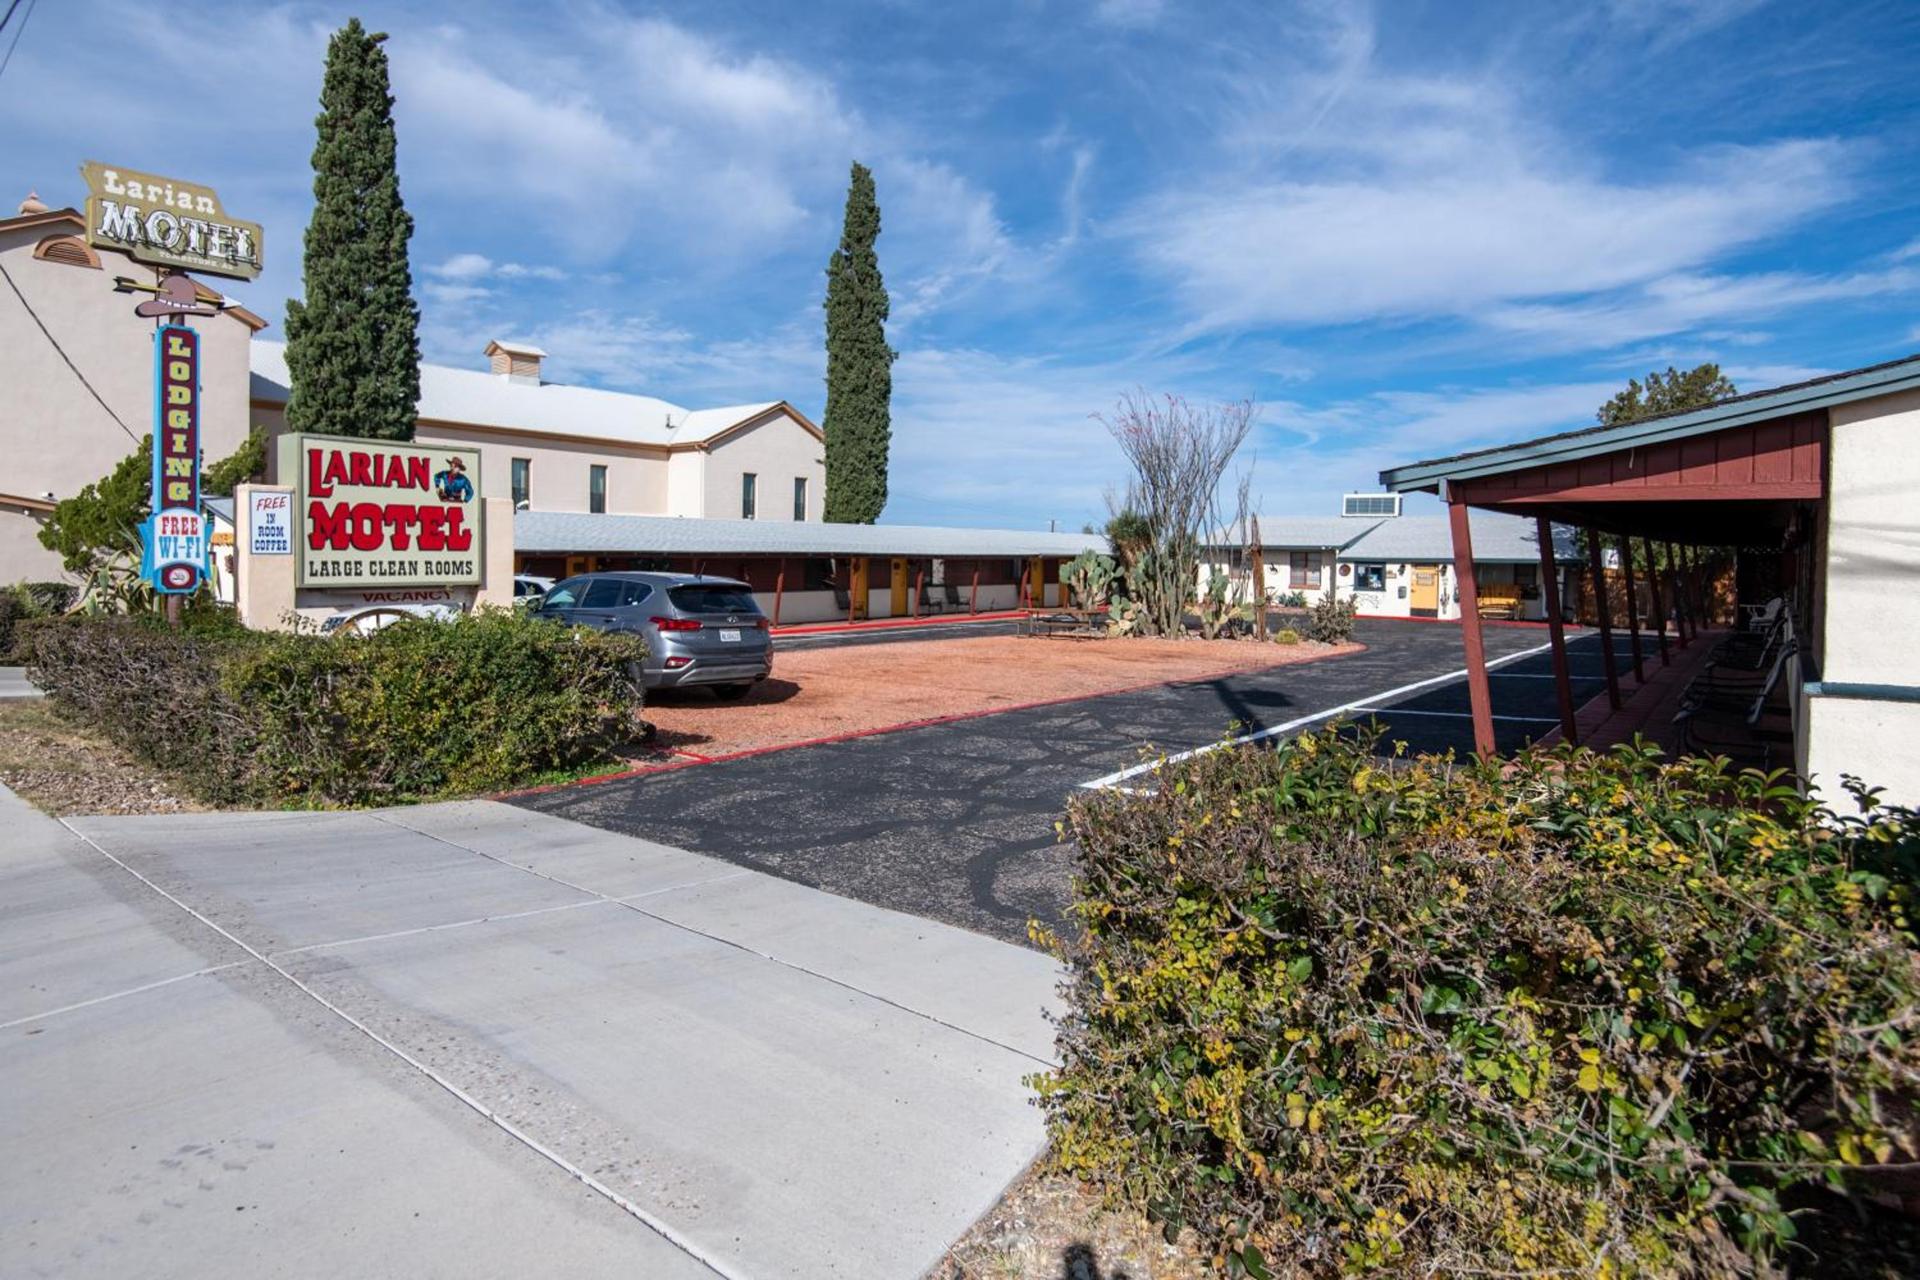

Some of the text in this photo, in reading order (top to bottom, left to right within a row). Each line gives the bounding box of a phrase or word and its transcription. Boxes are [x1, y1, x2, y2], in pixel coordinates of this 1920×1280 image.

[103, 170, 216, 215] Larian
[97, 200, 257, 264] MOTEL
[166, 336, 193, 501] LODGING
[308, 448, 431, 498] LARIAN
[256, 496, 287, 512] FREE
[161, 516, 198, 535] FREE
[266, 513, 276, 524] IN
[308, 501, 472, 551] MOTEL
[257, 526, 285, 538] ROOM
[158, 535, 201, 559] WI-FI
[254, 539, 288, 551] COFFEE
[308, 560, 473, 577] LARGE CLEAN ROOMS
[362, 590, 452, 602] VACANCY
